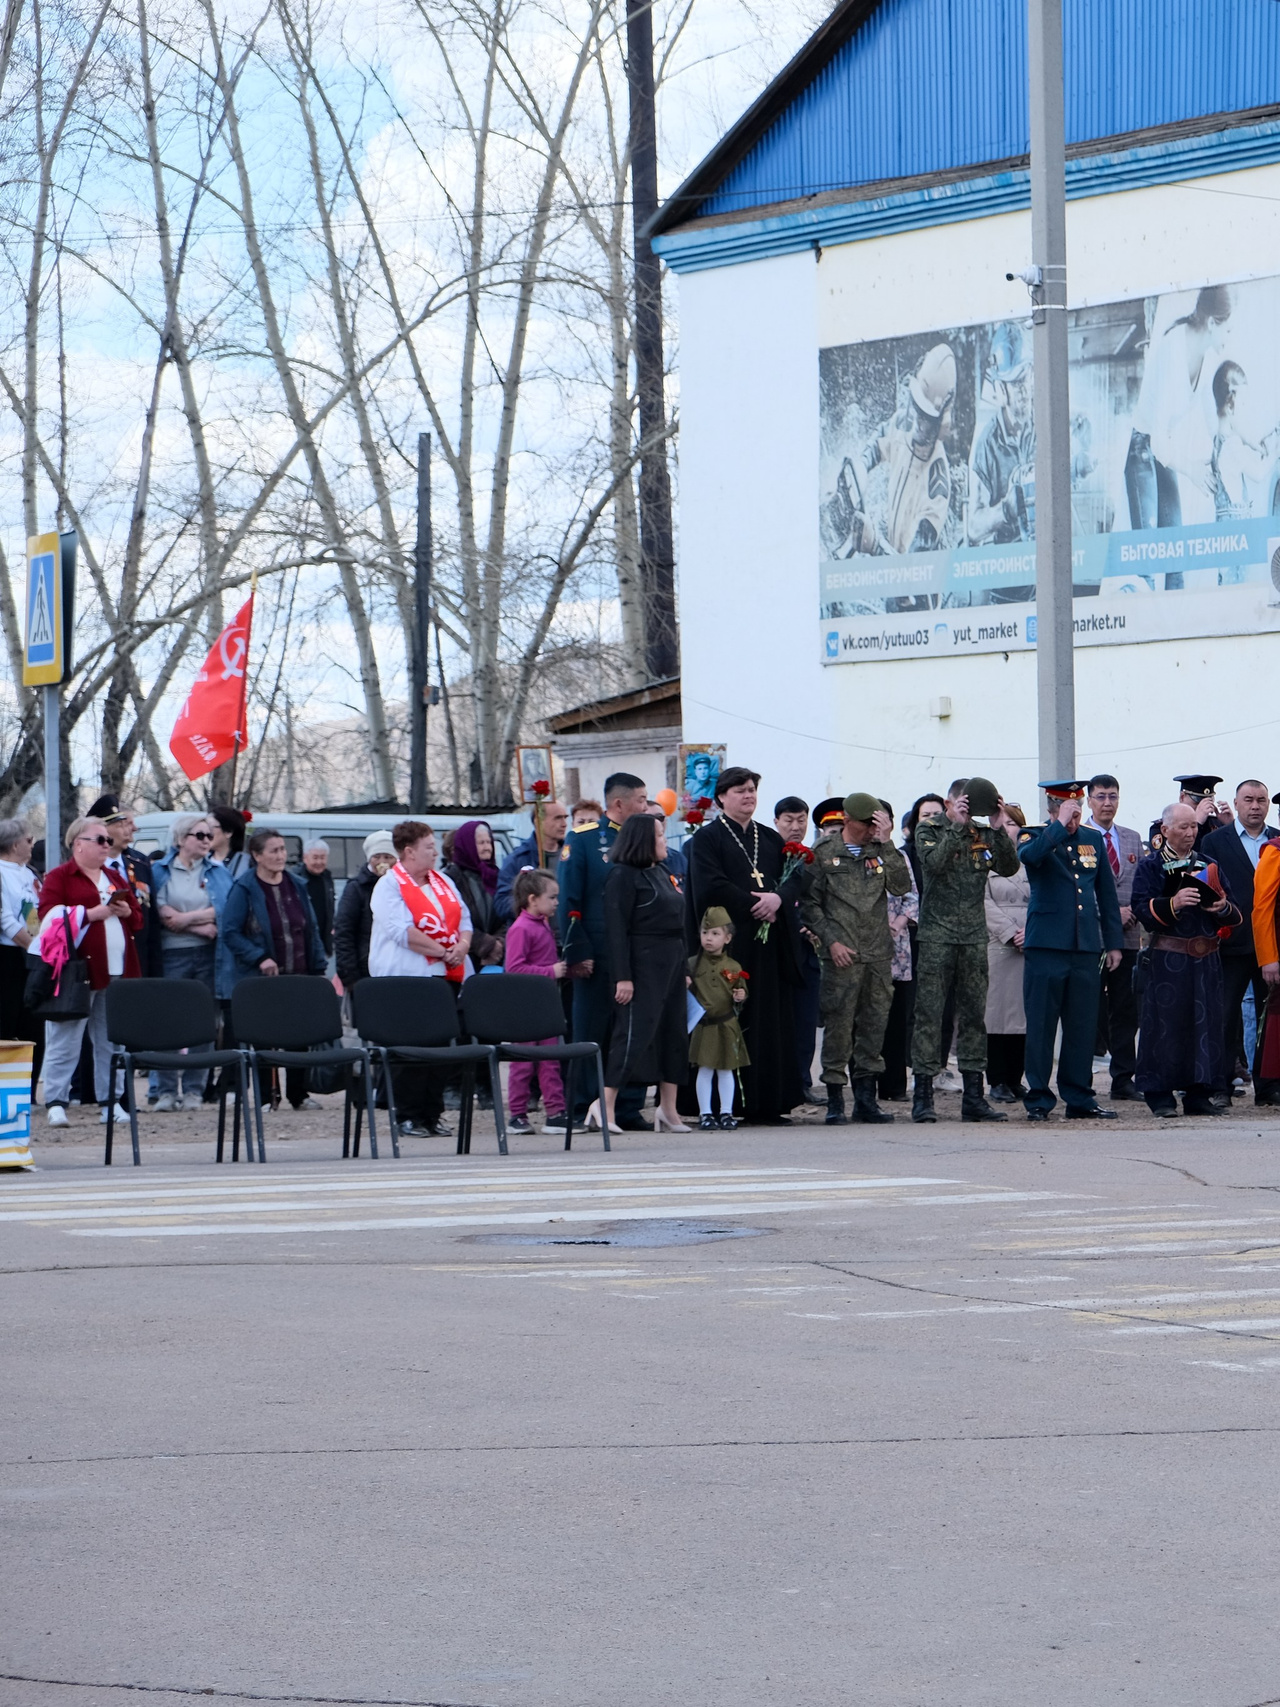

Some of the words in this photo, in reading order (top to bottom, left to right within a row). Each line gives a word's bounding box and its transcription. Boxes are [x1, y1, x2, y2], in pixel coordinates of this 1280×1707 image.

[1120, 540, 1184, 562] БЫТОВАЯ
[1187, 534, 1249, 556] ТЕХНИКА
[953, 550, 1086, 578] ЭЛЕКТРОИНСТНТ
[825, 565, 934, 590] БЕНЗОИНСТРУМЕНТ
[842, 629, 930, 651] vk.com/yutuu03
[953, 621, 1018, 645] yut_market
